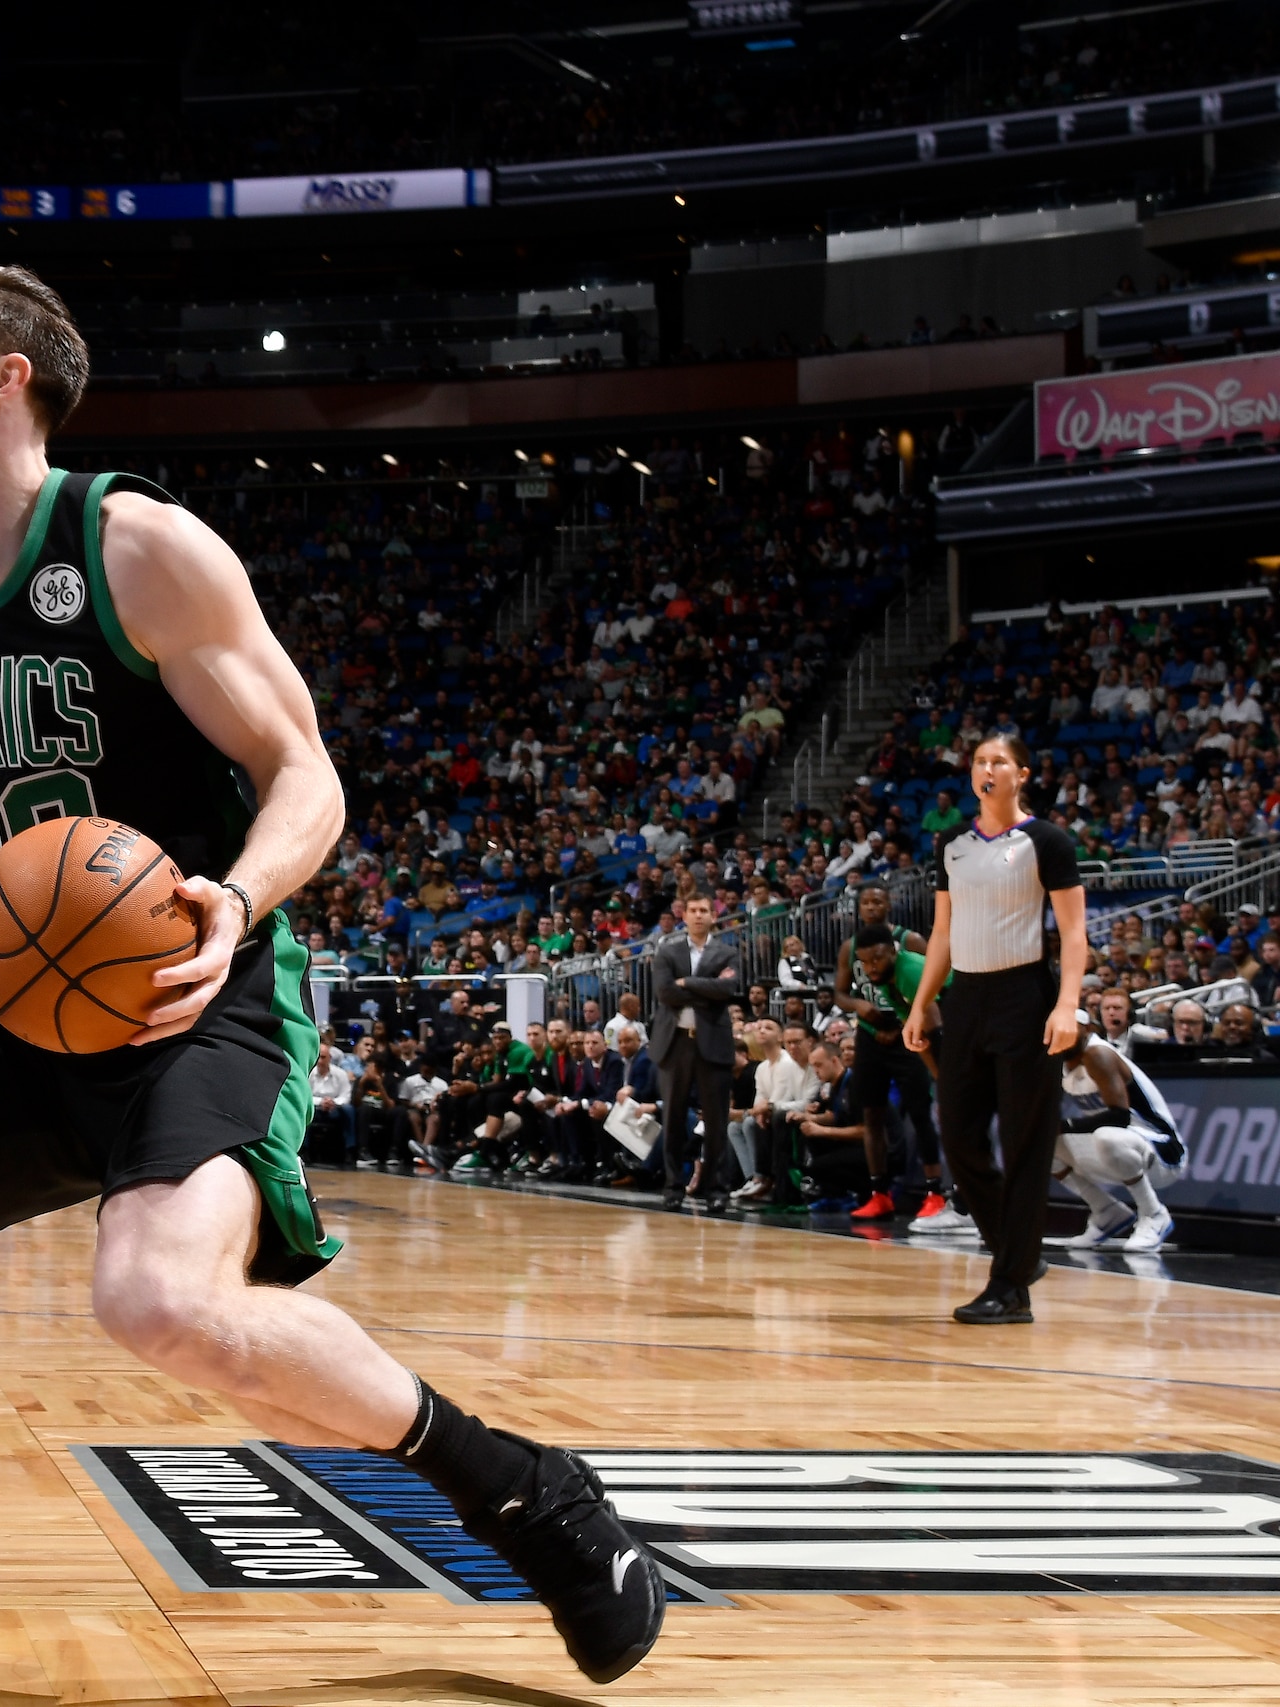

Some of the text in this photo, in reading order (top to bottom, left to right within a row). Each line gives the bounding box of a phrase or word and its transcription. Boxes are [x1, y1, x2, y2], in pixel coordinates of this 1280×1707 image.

[917, 88, 1280, 162] DEFEN
[35, 189, 56, 217] 3
[116, 188, 137, 216] 6
[126, 1450, 280, 1502] RICHARD
[200, 1528, 380, 1581] DEVOS
